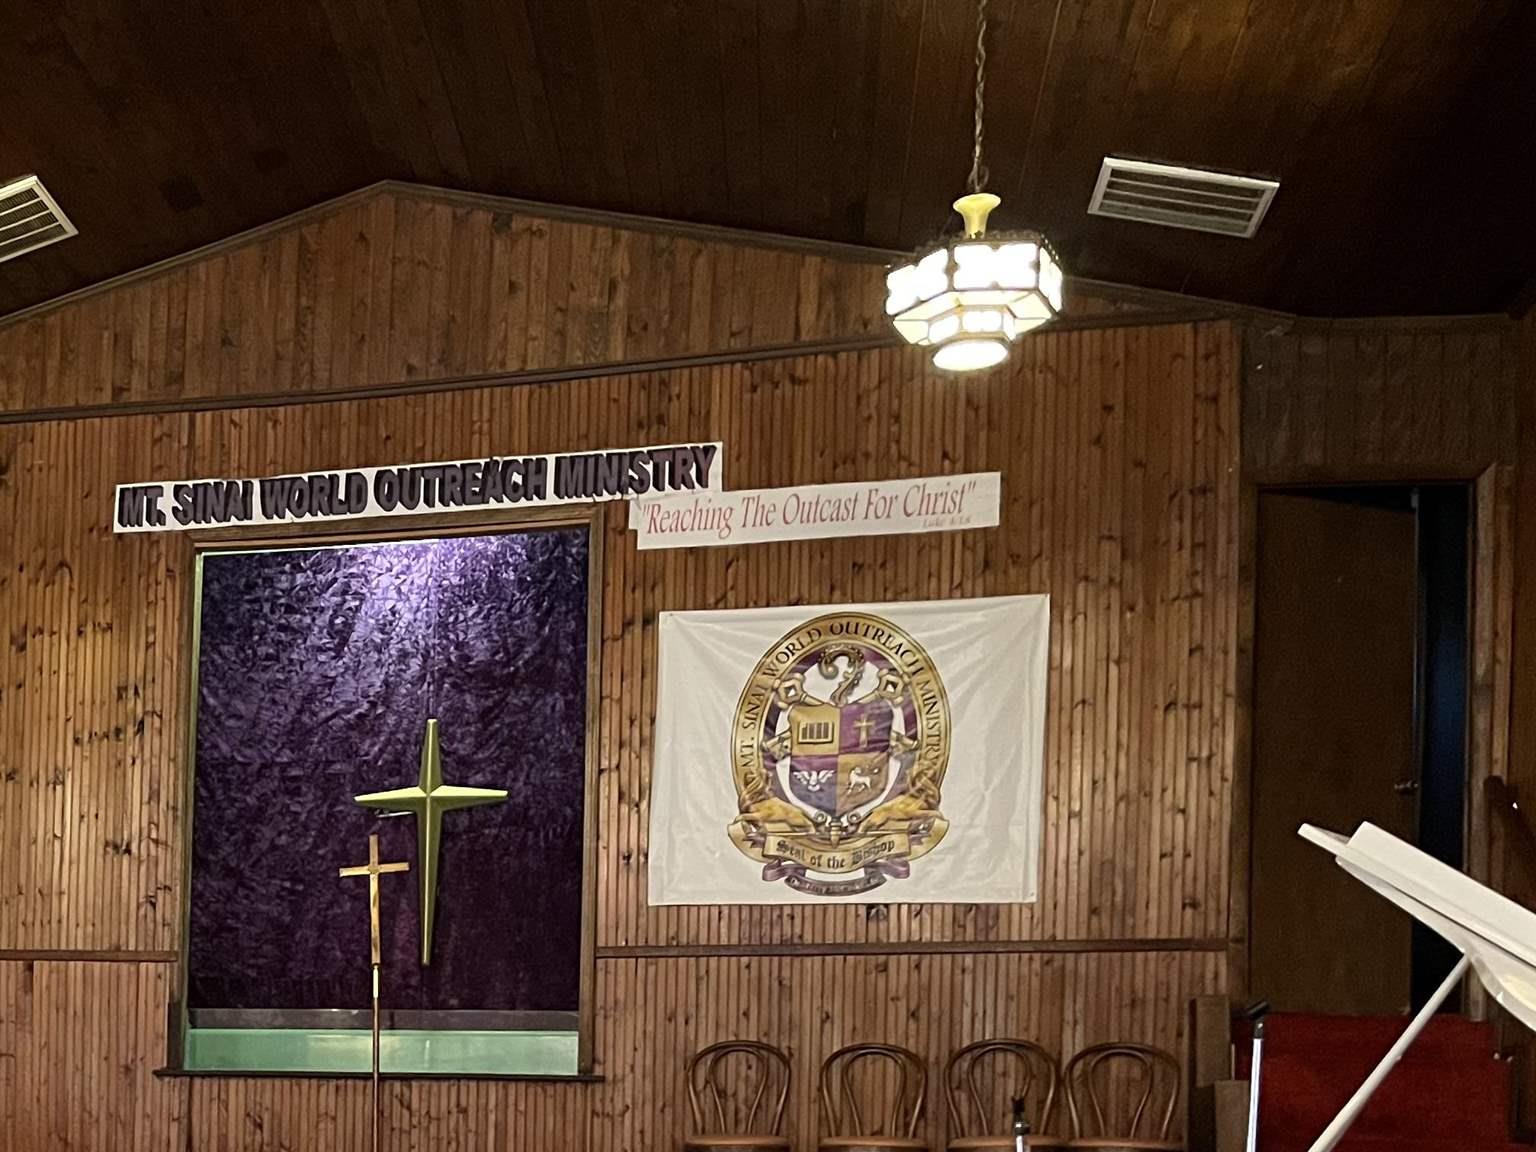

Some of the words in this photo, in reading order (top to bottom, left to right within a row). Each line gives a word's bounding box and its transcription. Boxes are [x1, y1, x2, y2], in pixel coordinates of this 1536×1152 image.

[118, 487, 165, 528] MT.
[171, 478, 254, 526] SINAI
[261, 471, 370, 521] WORLD
[378, 456, 547, 512] OUTREACH
[553, 445, 719, 499] MINISTRY
[642, 498, 734, 540] "Reaching
[740, 496, 777, 529] The
[782, 492, 858, 525] Outcast
[864, 488, 900, 520] For
[902, 479, 977, 519] Christ"
[763, 627, 822, 678] WORLD
[829, 621, 924, 678] OUTREACH
[742, 684, 765, 730] SINAI
[918, 680, 941, 766] MINISTRY
[740, 736, 757, 769] MT.
[810, 854, 821, 867] of
[827, 856, 845, 869] the
